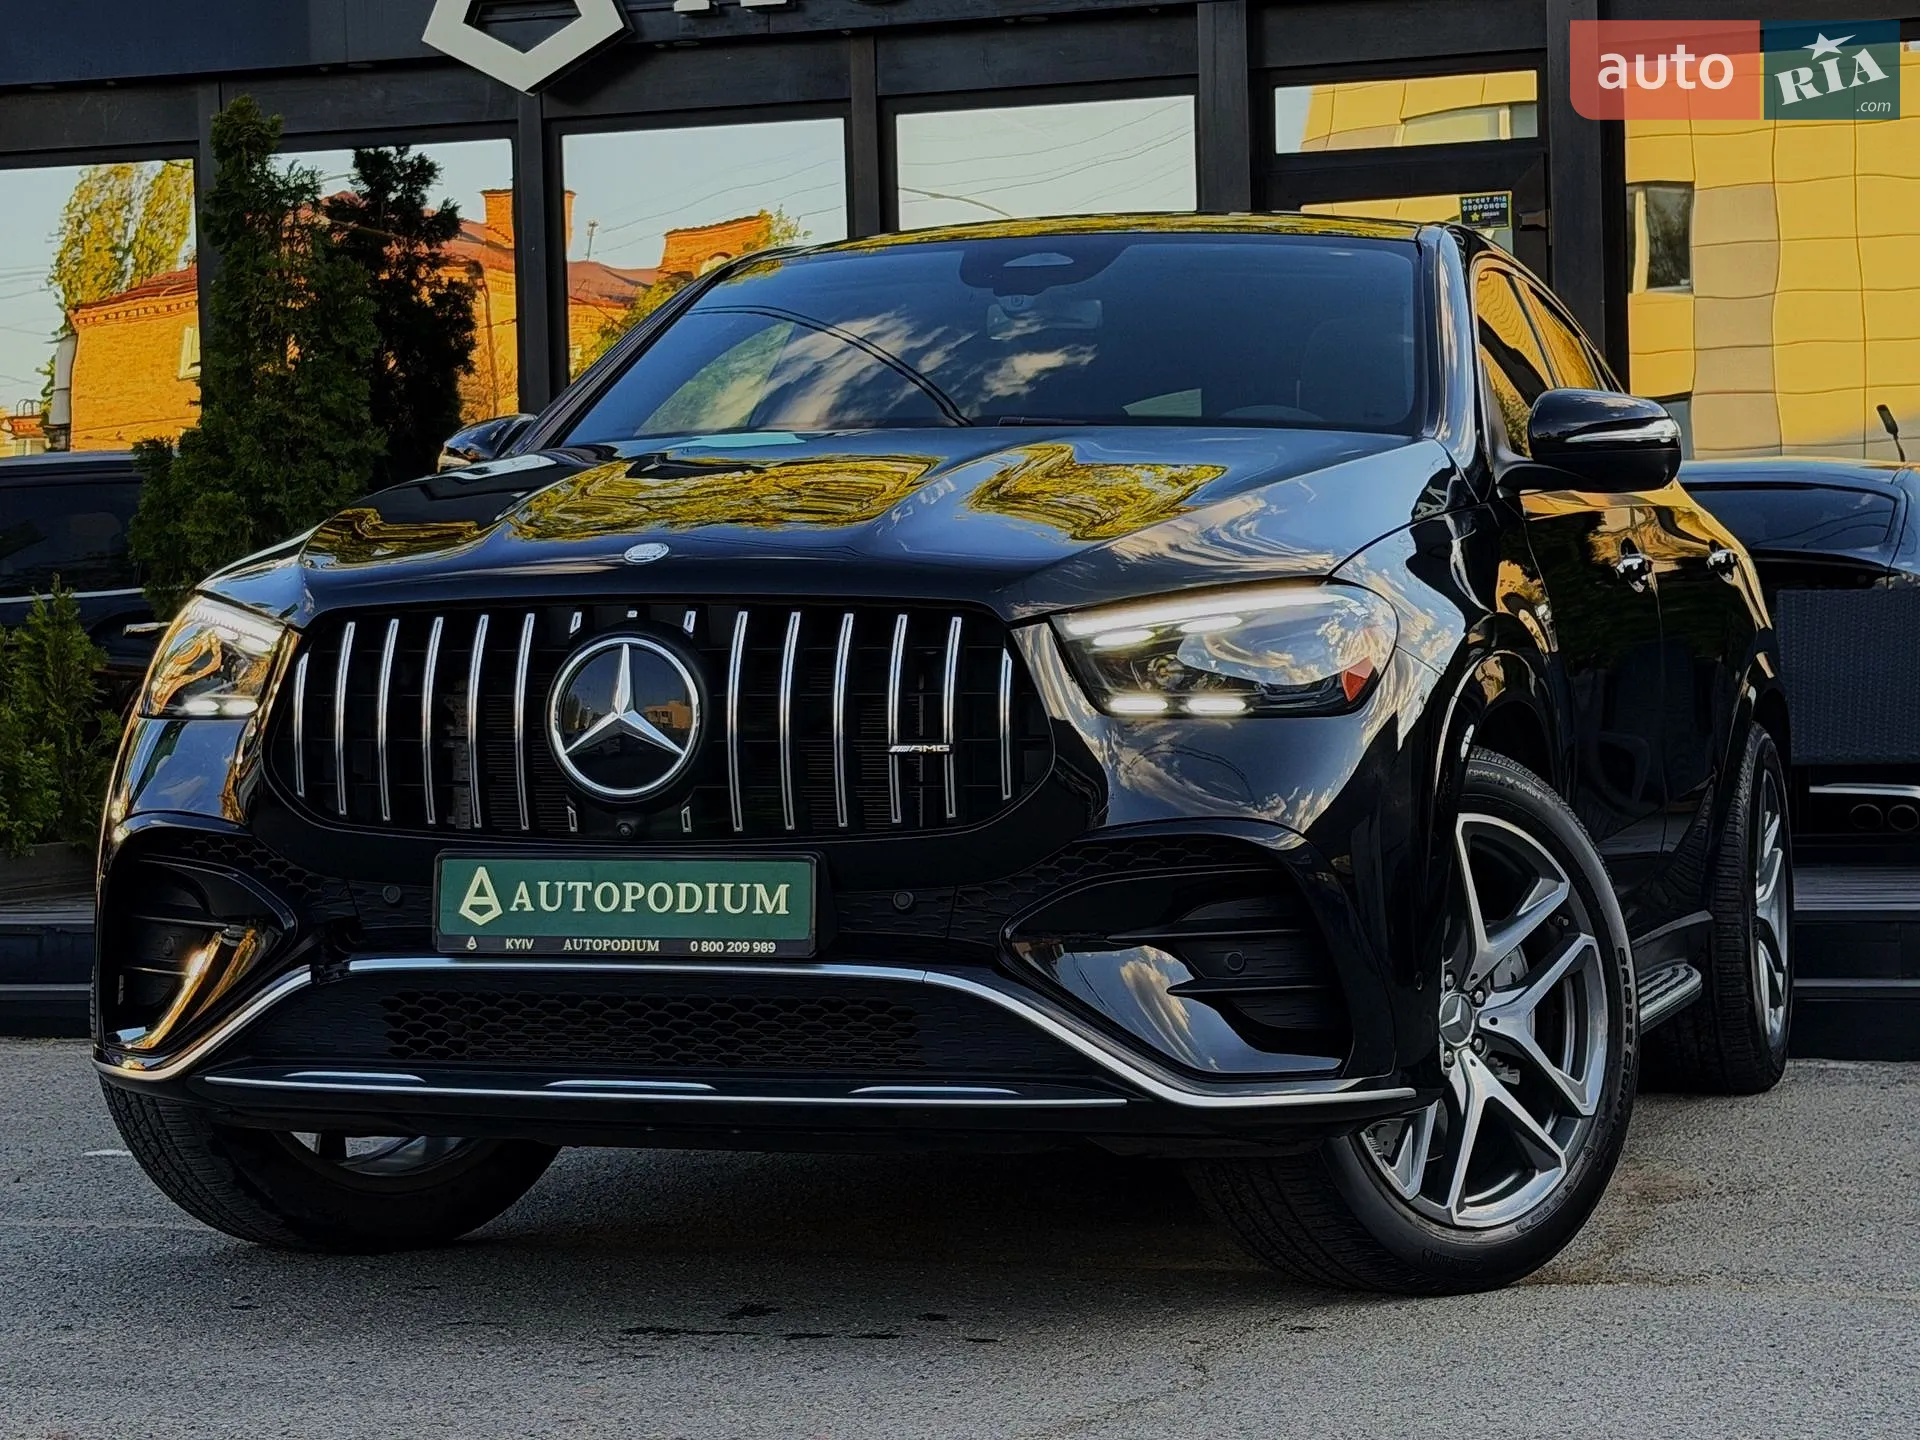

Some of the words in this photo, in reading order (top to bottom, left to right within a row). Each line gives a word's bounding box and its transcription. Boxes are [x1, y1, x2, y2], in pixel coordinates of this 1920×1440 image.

[509, 880, 791, 915] AUTOPODIUM
[505, 938, 534, 950] KYIV
[563, 939, 660, 952] AUTOPODIUM
[690, 941, 698, 952] 0
[700, 942, 724, 953] 800
[726, 942, 751, 953] 209
[753, 942, 776, 954] 989
